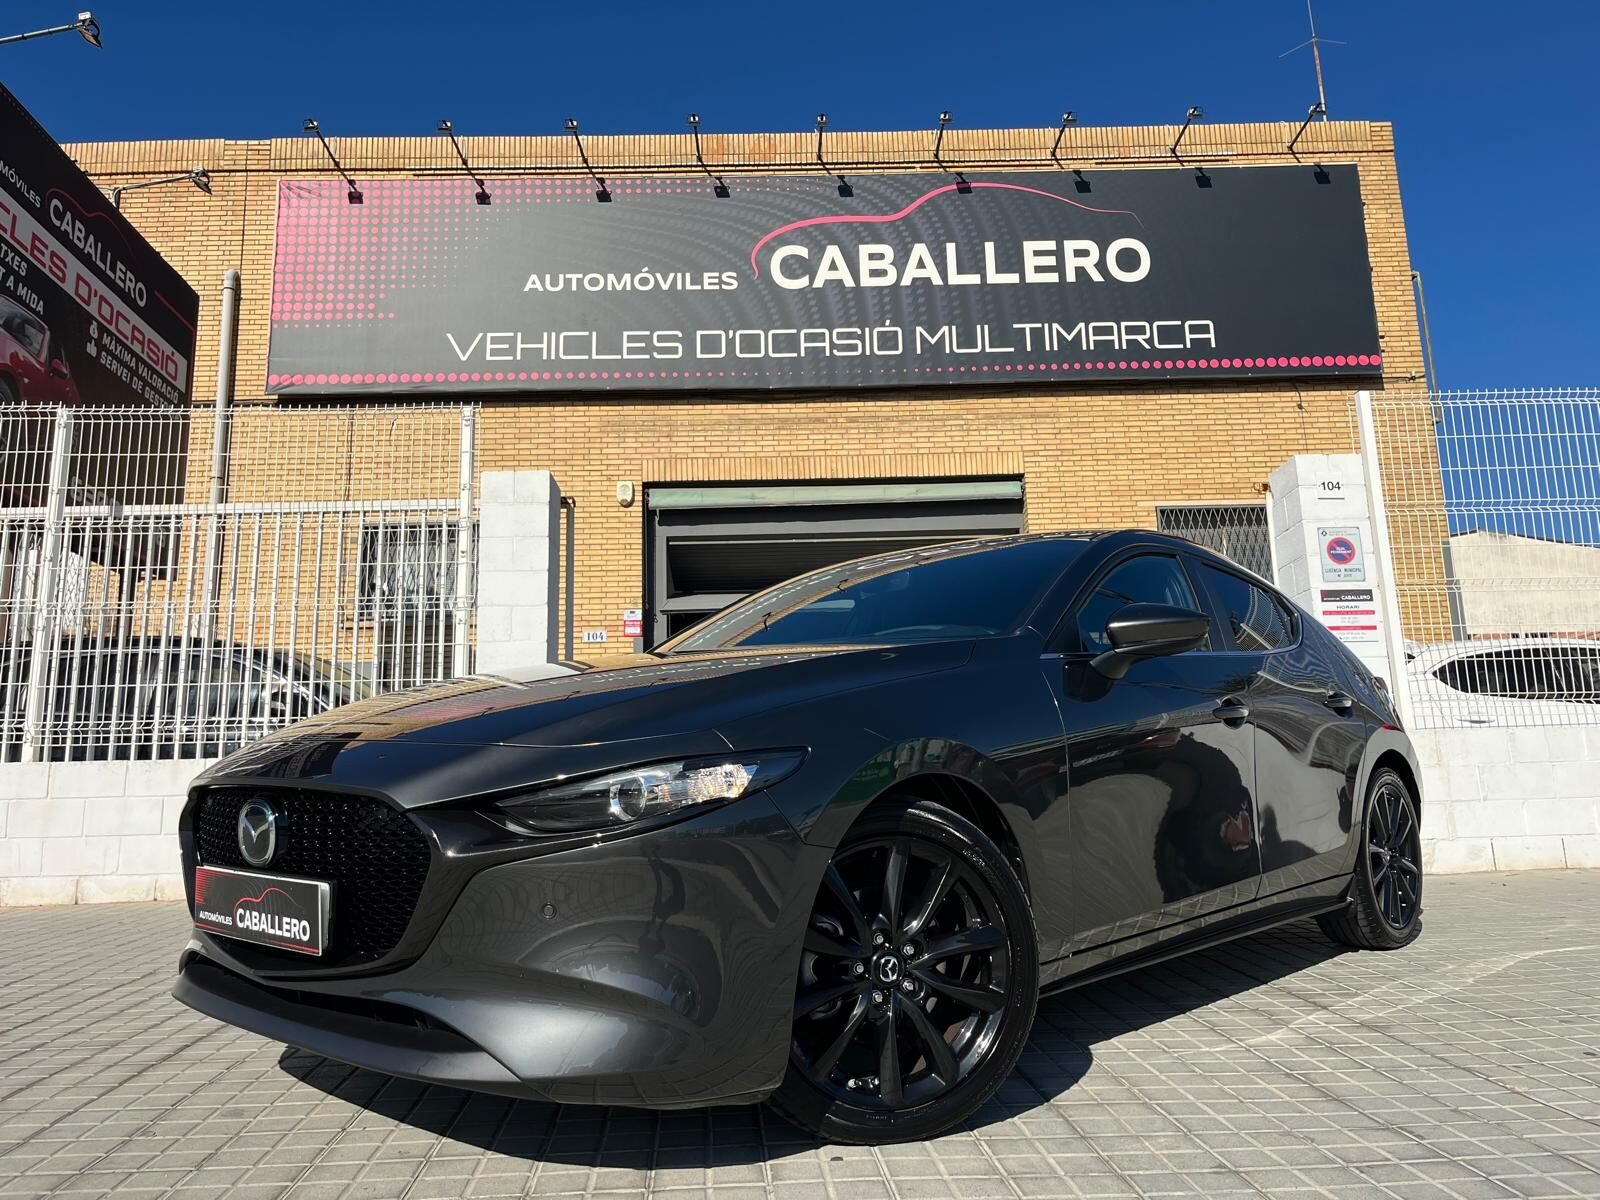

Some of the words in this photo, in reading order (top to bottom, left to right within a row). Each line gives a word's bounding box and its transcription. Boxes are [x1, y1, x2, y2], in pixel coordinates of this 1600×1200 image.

[0, 243, 28, 277] TXES
[50, 198, 148, 308] CABALLERO
[523, 267, 739, 292] AUTOMÓVILES
[769, 237, 1152, 290] CABALLERO
[6, 275, 14, 291] A
[17, 282, 44, 315] MIDA
[75, 272, 179, 382] D'OCASIÓ
[446, 331, 683, 361] VEHICLES
[696, 320, 903, 358] D'OCASIÓ
[916, 319, 1216, 355] MULTIMARCA
[100, 351, 131, 384] SERVEI
[132, 375, 143, 394] DE
[138, 361, 179, 404] VALORACIÓ
[1320, 481, 1342, 491] 104
[587, 631, 604, 641] 104
[199, 910, 233, 926] AUTOMÓVILES
[236, 908, 310, 941] CABALLERO
